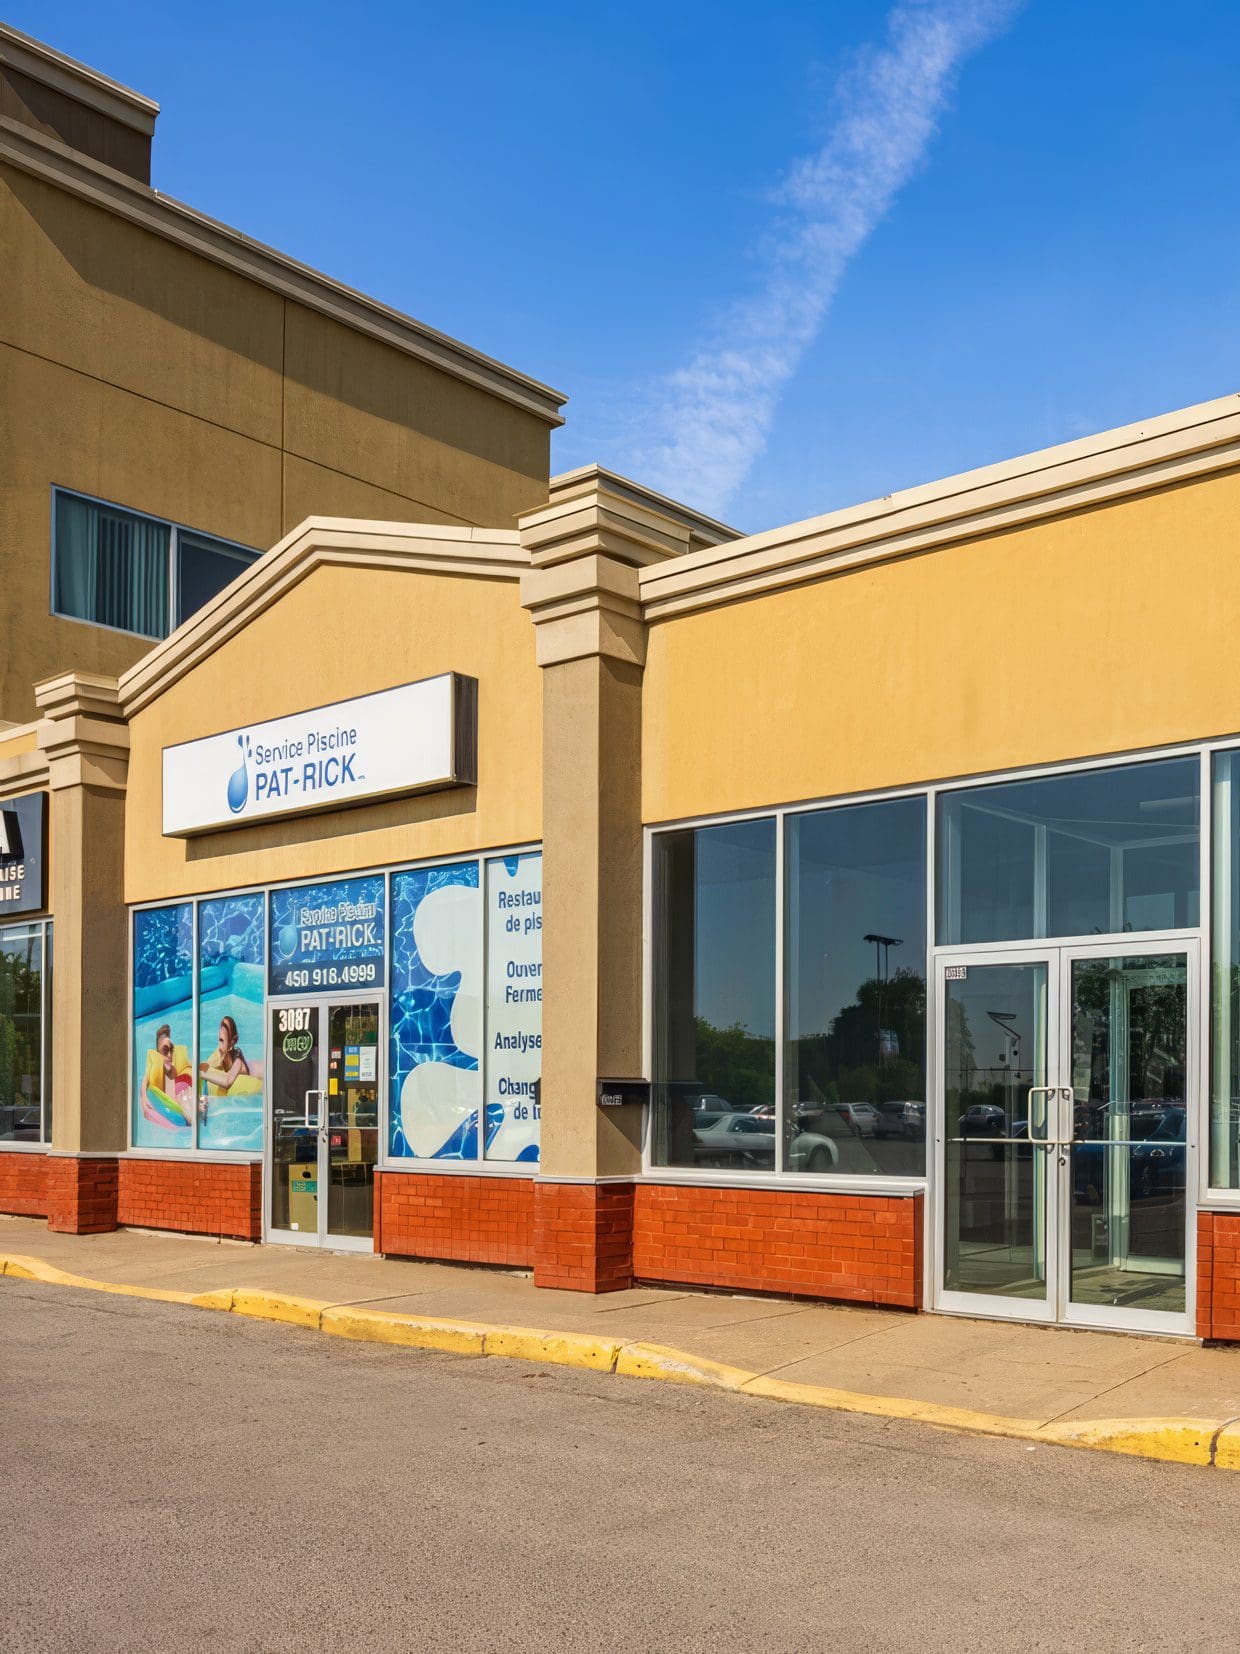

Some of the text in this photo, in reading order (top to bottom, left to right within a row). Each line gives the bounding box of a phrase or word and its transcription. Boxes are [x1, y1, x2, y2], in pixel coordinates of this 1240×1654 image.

[255, 726, 357, 765] Service Piscine
[255, 752, 356, 801] PAT-RICK
[498, 890, 541, 909] Restau
[505, 912, 543, 935] de pis
[301, 922, 376, 952] PAT-RICK
[285, 969, 309, 987] 450
[505, 986, 543, 1004] Ferme
[279, 1008, 311, 1032] 3087
[494, 1031, 542, 1053] Analyse
[514, 1102, 528, 1120] de
